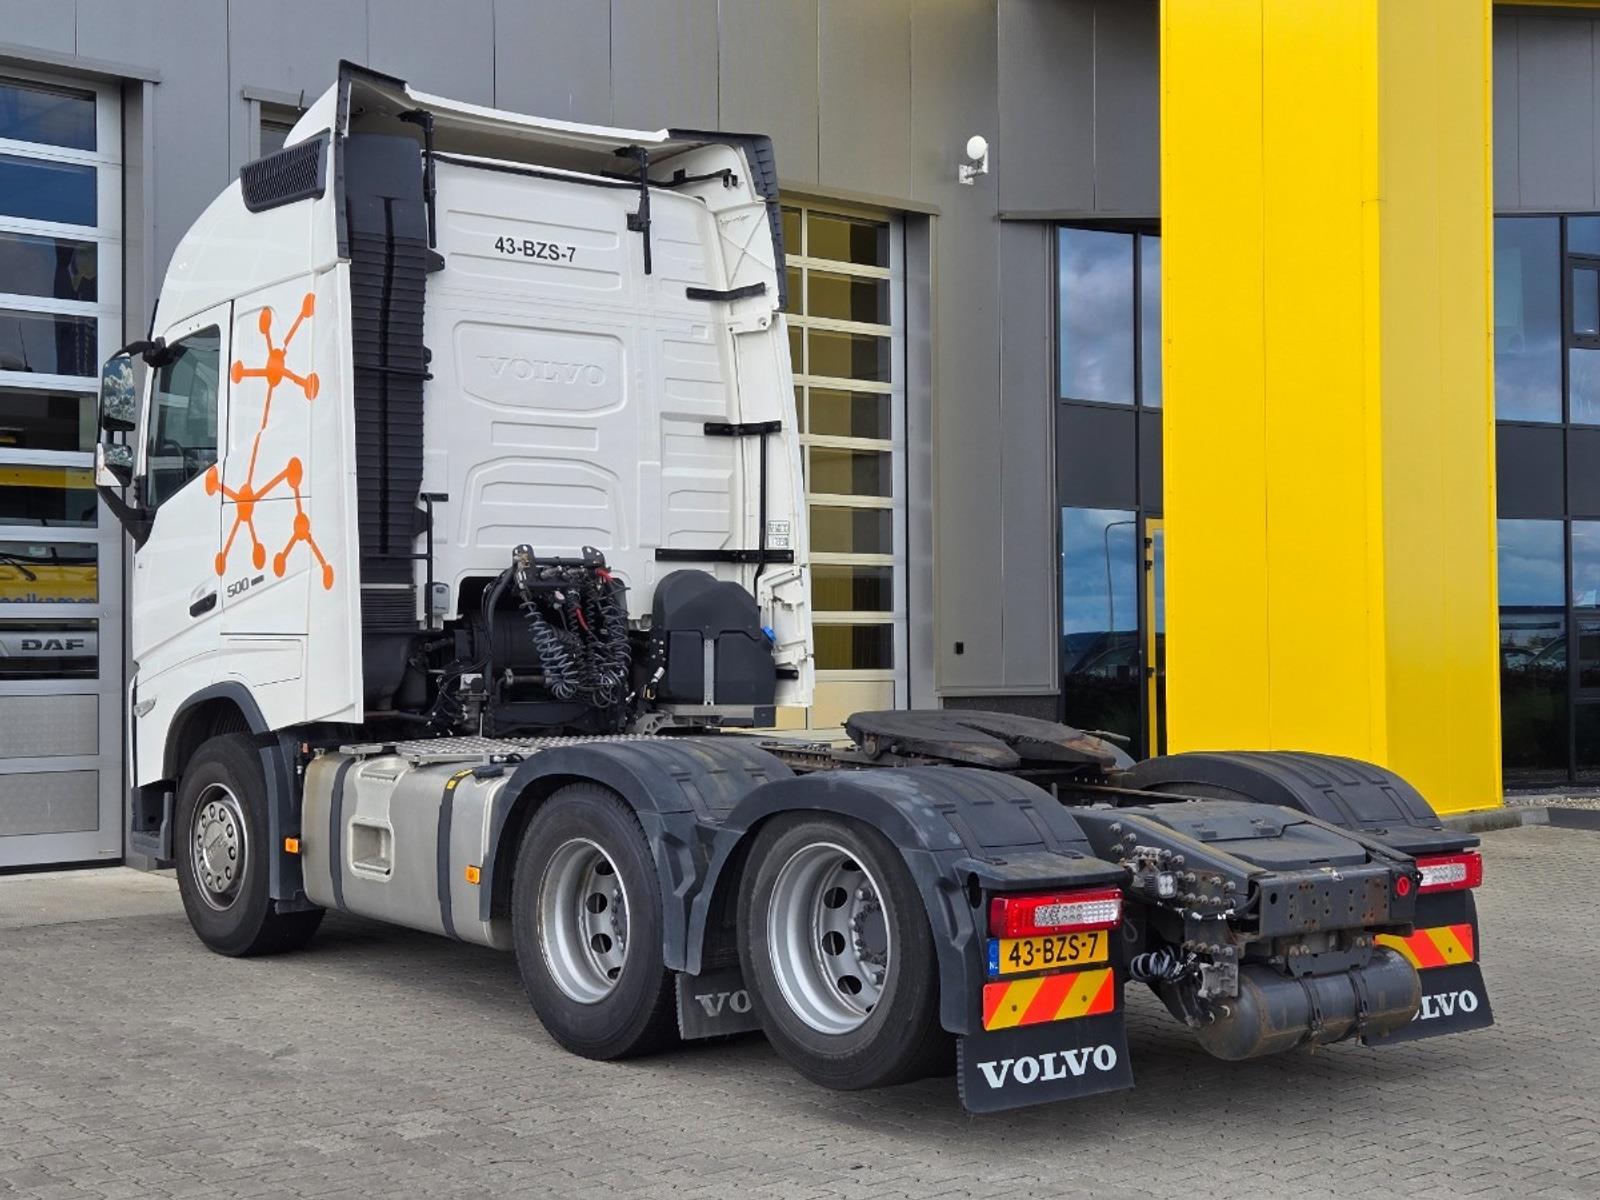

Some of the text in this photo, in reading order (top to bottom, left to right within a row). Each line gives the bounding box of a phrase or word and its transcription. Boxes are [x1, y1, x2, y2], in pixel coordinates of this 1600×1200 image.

[495, 236, 576, 262] 43-BZS-7
[476, 355, 606, 387] VOLVO
[227, 577, 249, 598] 500
[21, 639, 84, 651] DAF
[1008, 933, 1098, 967] 43-BZS-7
[1411, 989, 1479, 1021] LVO
[977, 1044, 1117, 1089] VOLVO
